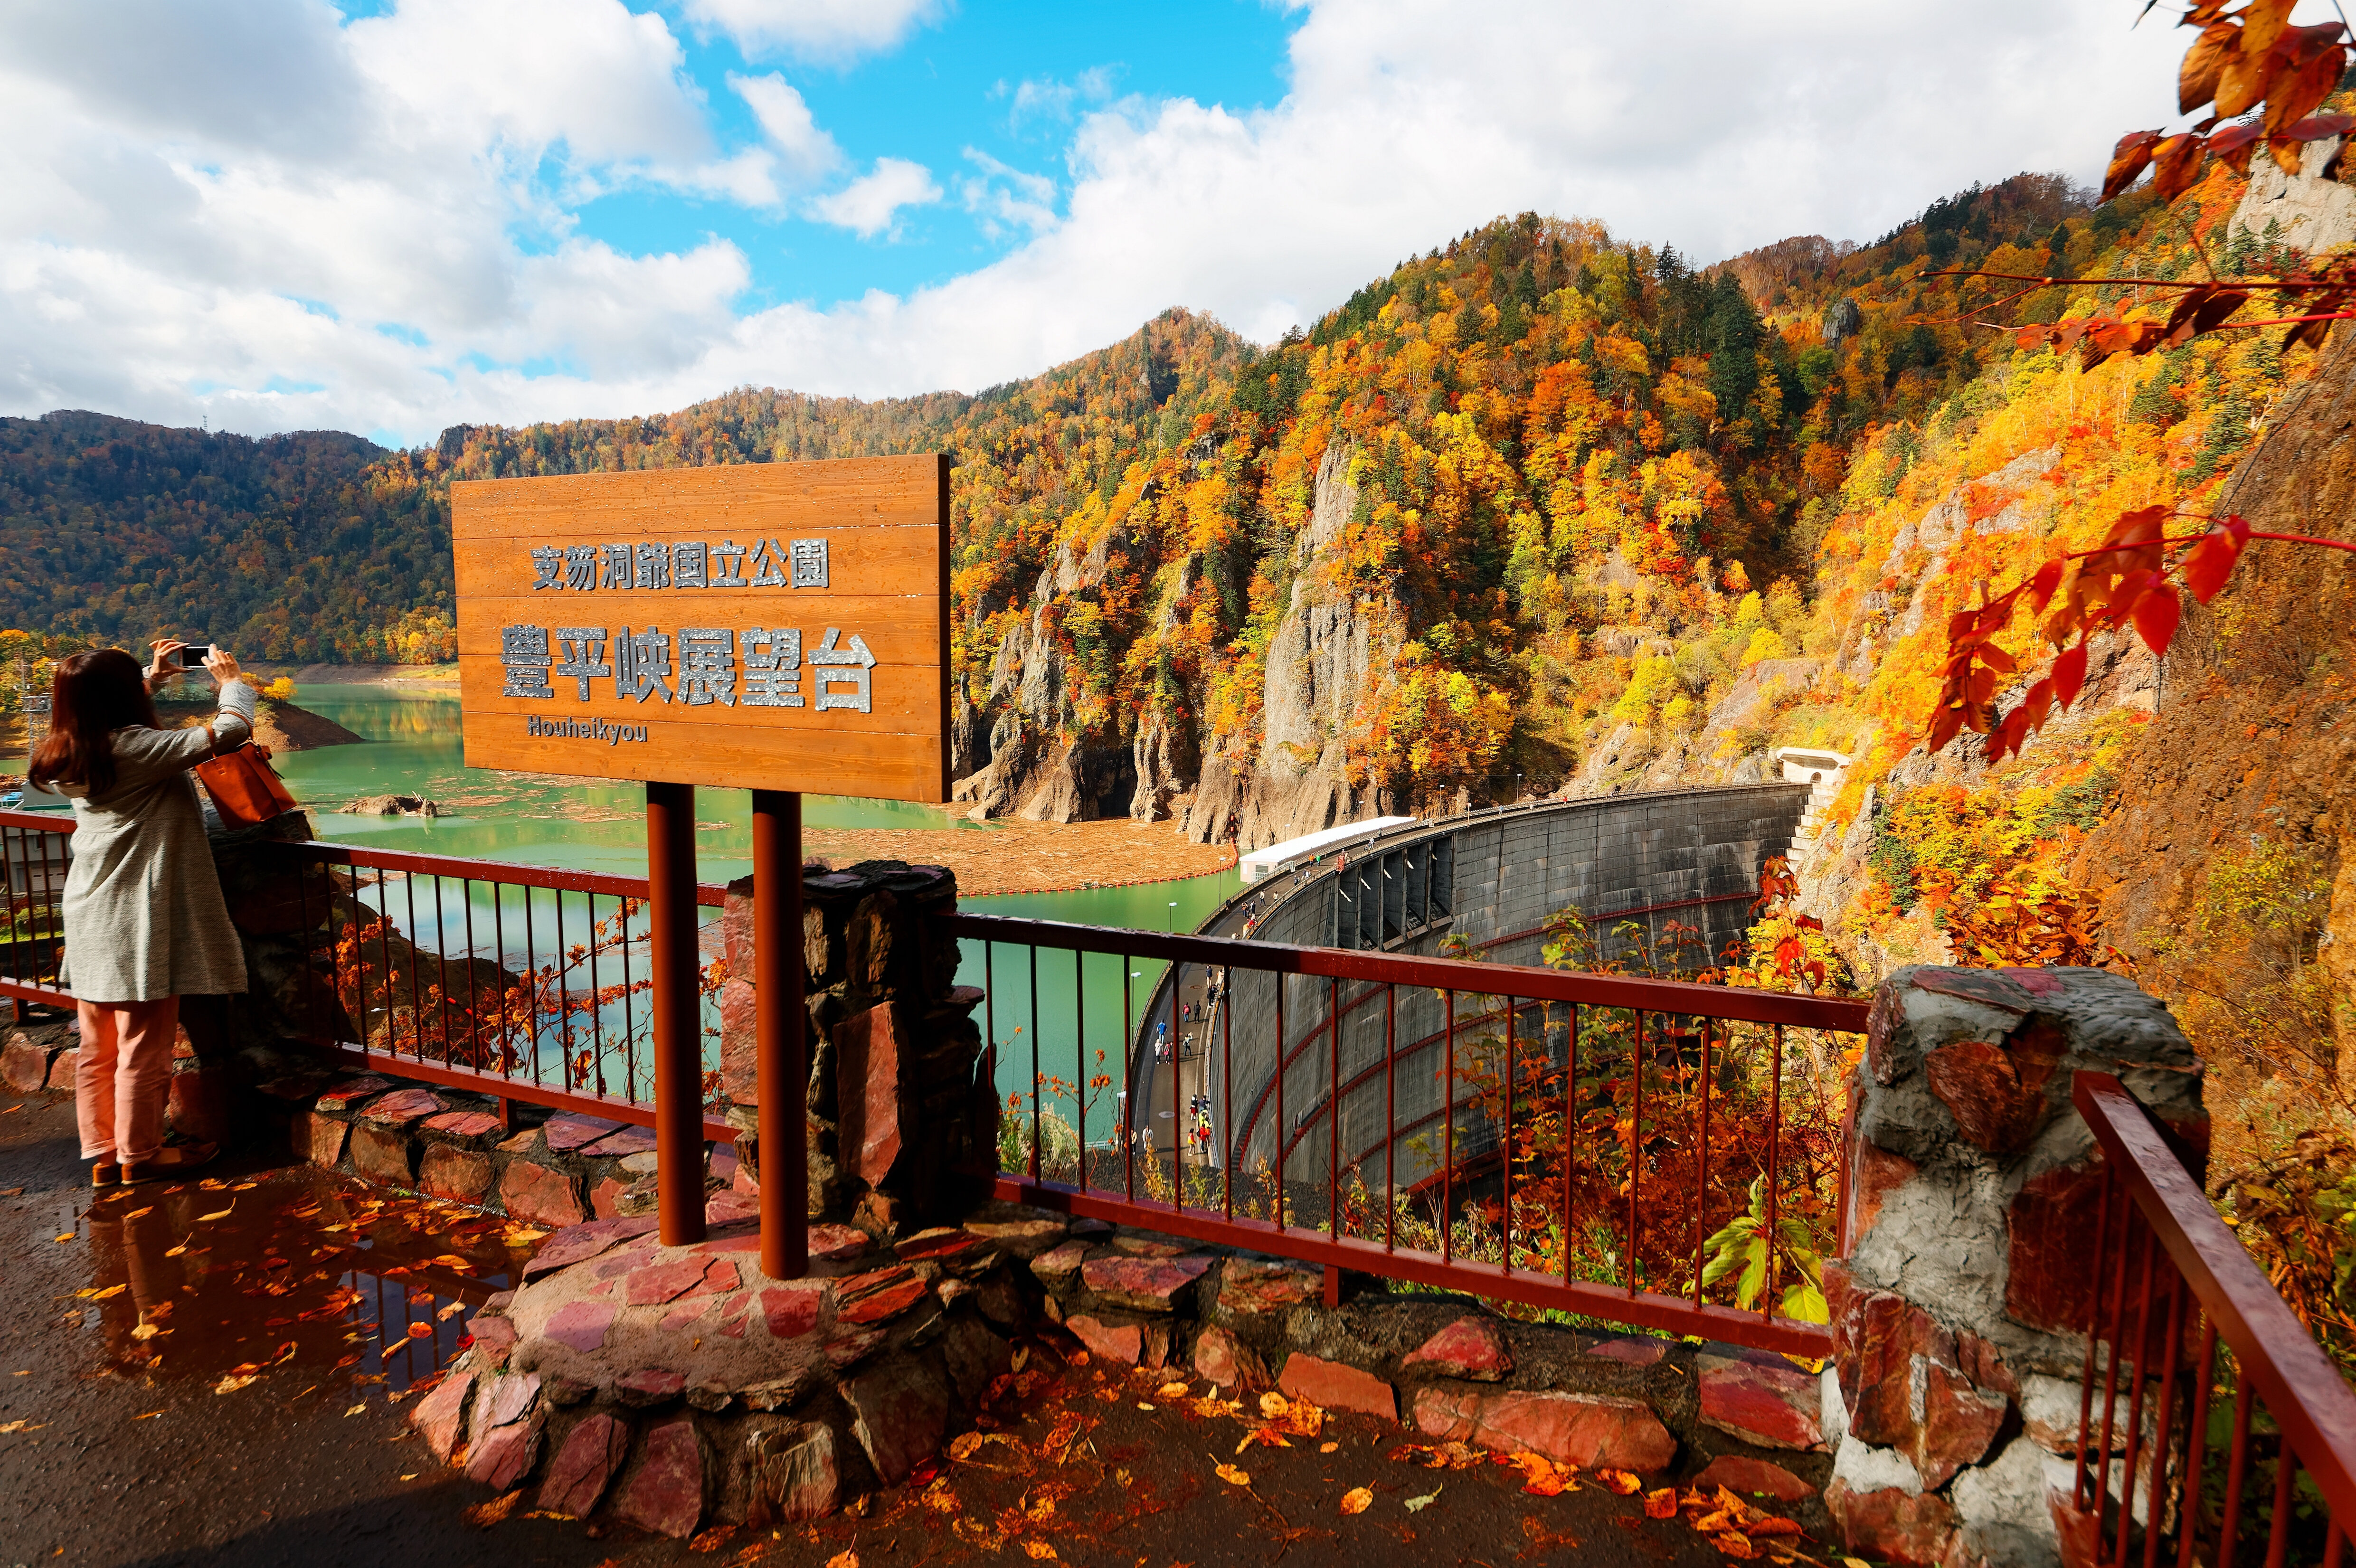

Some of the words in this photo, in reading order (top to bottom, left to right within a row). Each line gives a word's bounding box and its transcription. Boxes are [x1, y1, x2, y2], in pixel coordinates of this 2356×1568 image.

[531, 538, 829, 591] 支笏洞爺国立公園
[500, 624, 876, 713] 豊平峡展望台
[528, 715, 647, 746] Houheikyou
